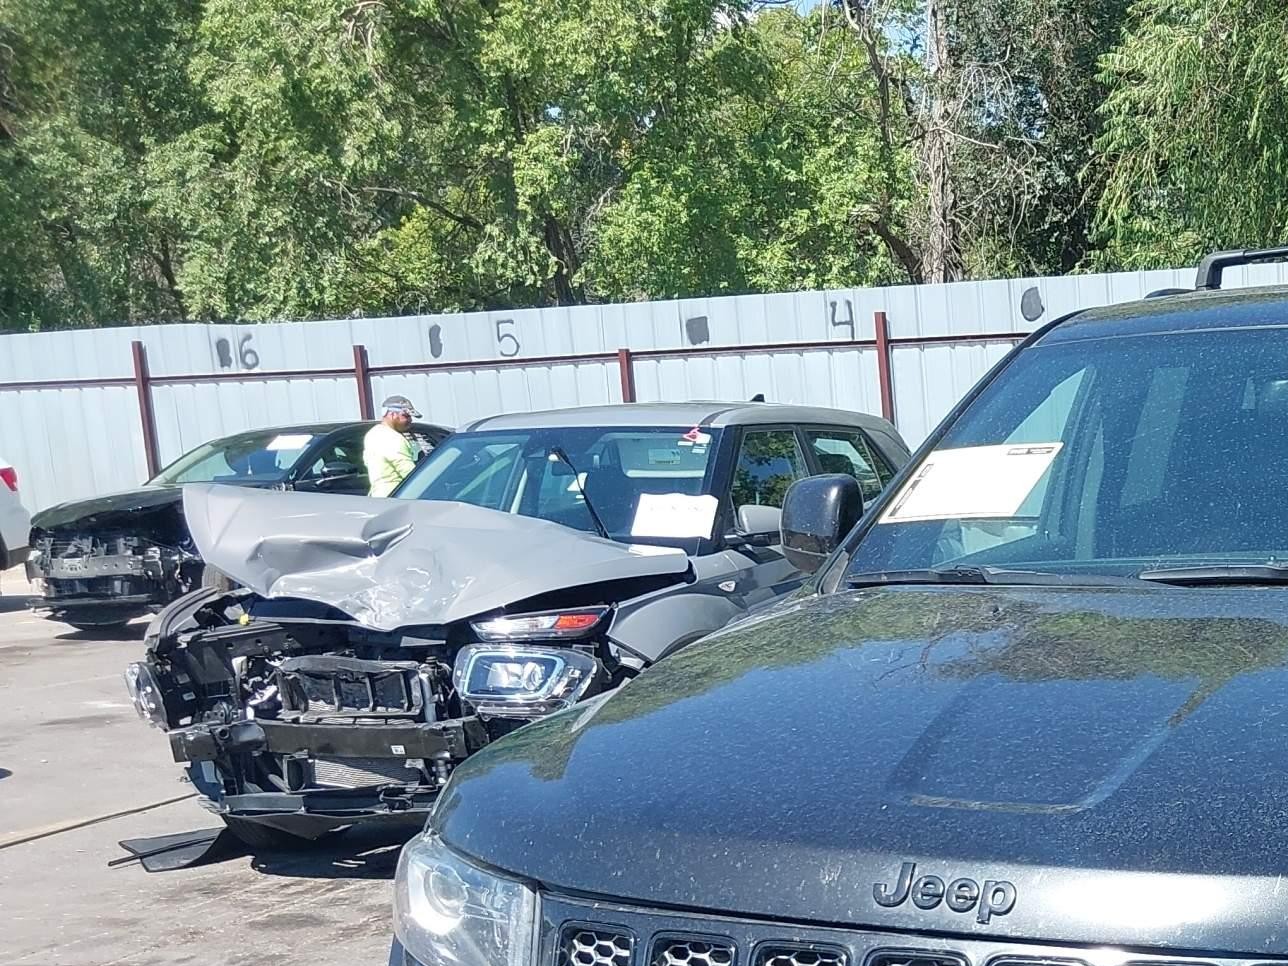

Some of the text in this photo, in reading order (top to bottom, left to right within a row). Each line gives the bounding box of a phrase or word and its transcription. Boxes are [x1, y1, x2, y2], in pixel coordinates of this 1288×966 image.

[496, 319, 520, 358] 5
[830, 299, 855, 340] 4
[239, 334, 260, 370] 6
[873, 862, 1017, 925] Jeep
